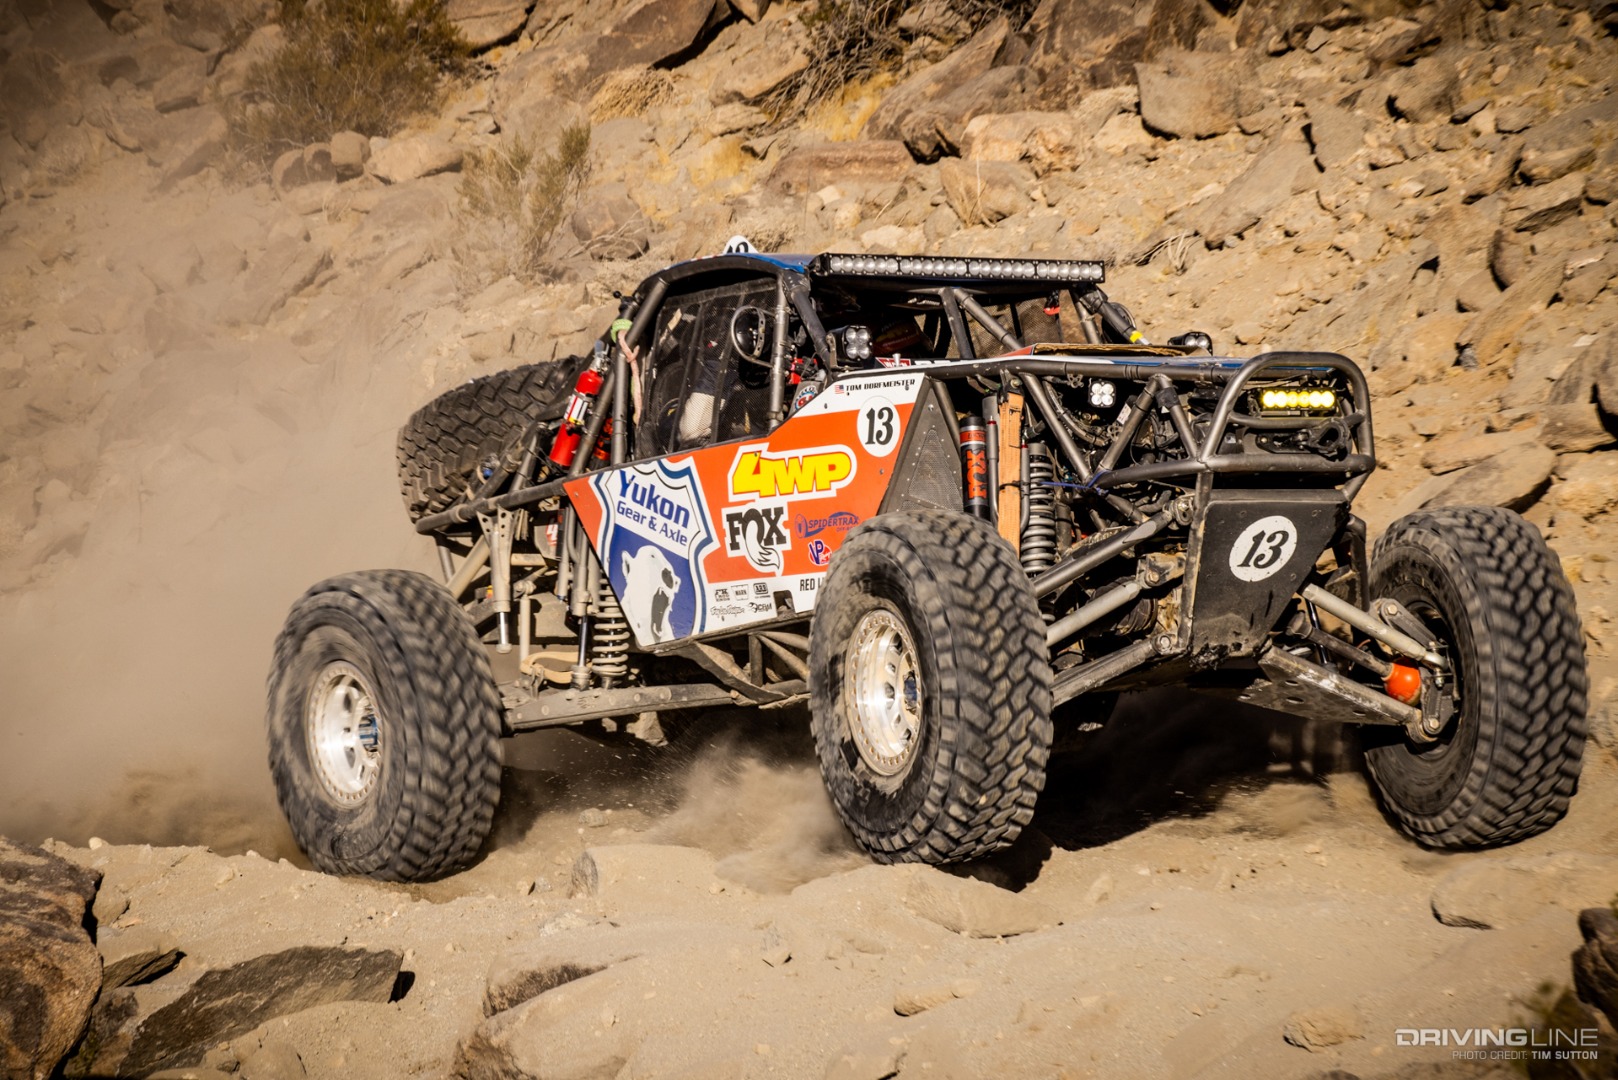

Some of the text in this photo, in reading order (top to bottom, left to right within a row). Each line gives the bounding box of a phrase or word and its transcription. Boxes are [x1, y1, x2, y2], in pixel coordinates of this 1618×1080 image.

[846, 378, 916, 392] TOM DORFMEISTER
[864, 406, 894, 446] 13
[731, 450, 853, 499] 4WP
[966, 450, 987, 499] FOX
[616, 470, 690, 528] Yukon
[616, 501, 689, 547] Gear & Axle
[726, 506, 788, 553] FOX
[807, 515, 860, 530] SPIDERTRAX
[808, 540, 825, 565] VP
[1236, 529, 1290, 570] 13
[799, 577, 816, 592] RED
